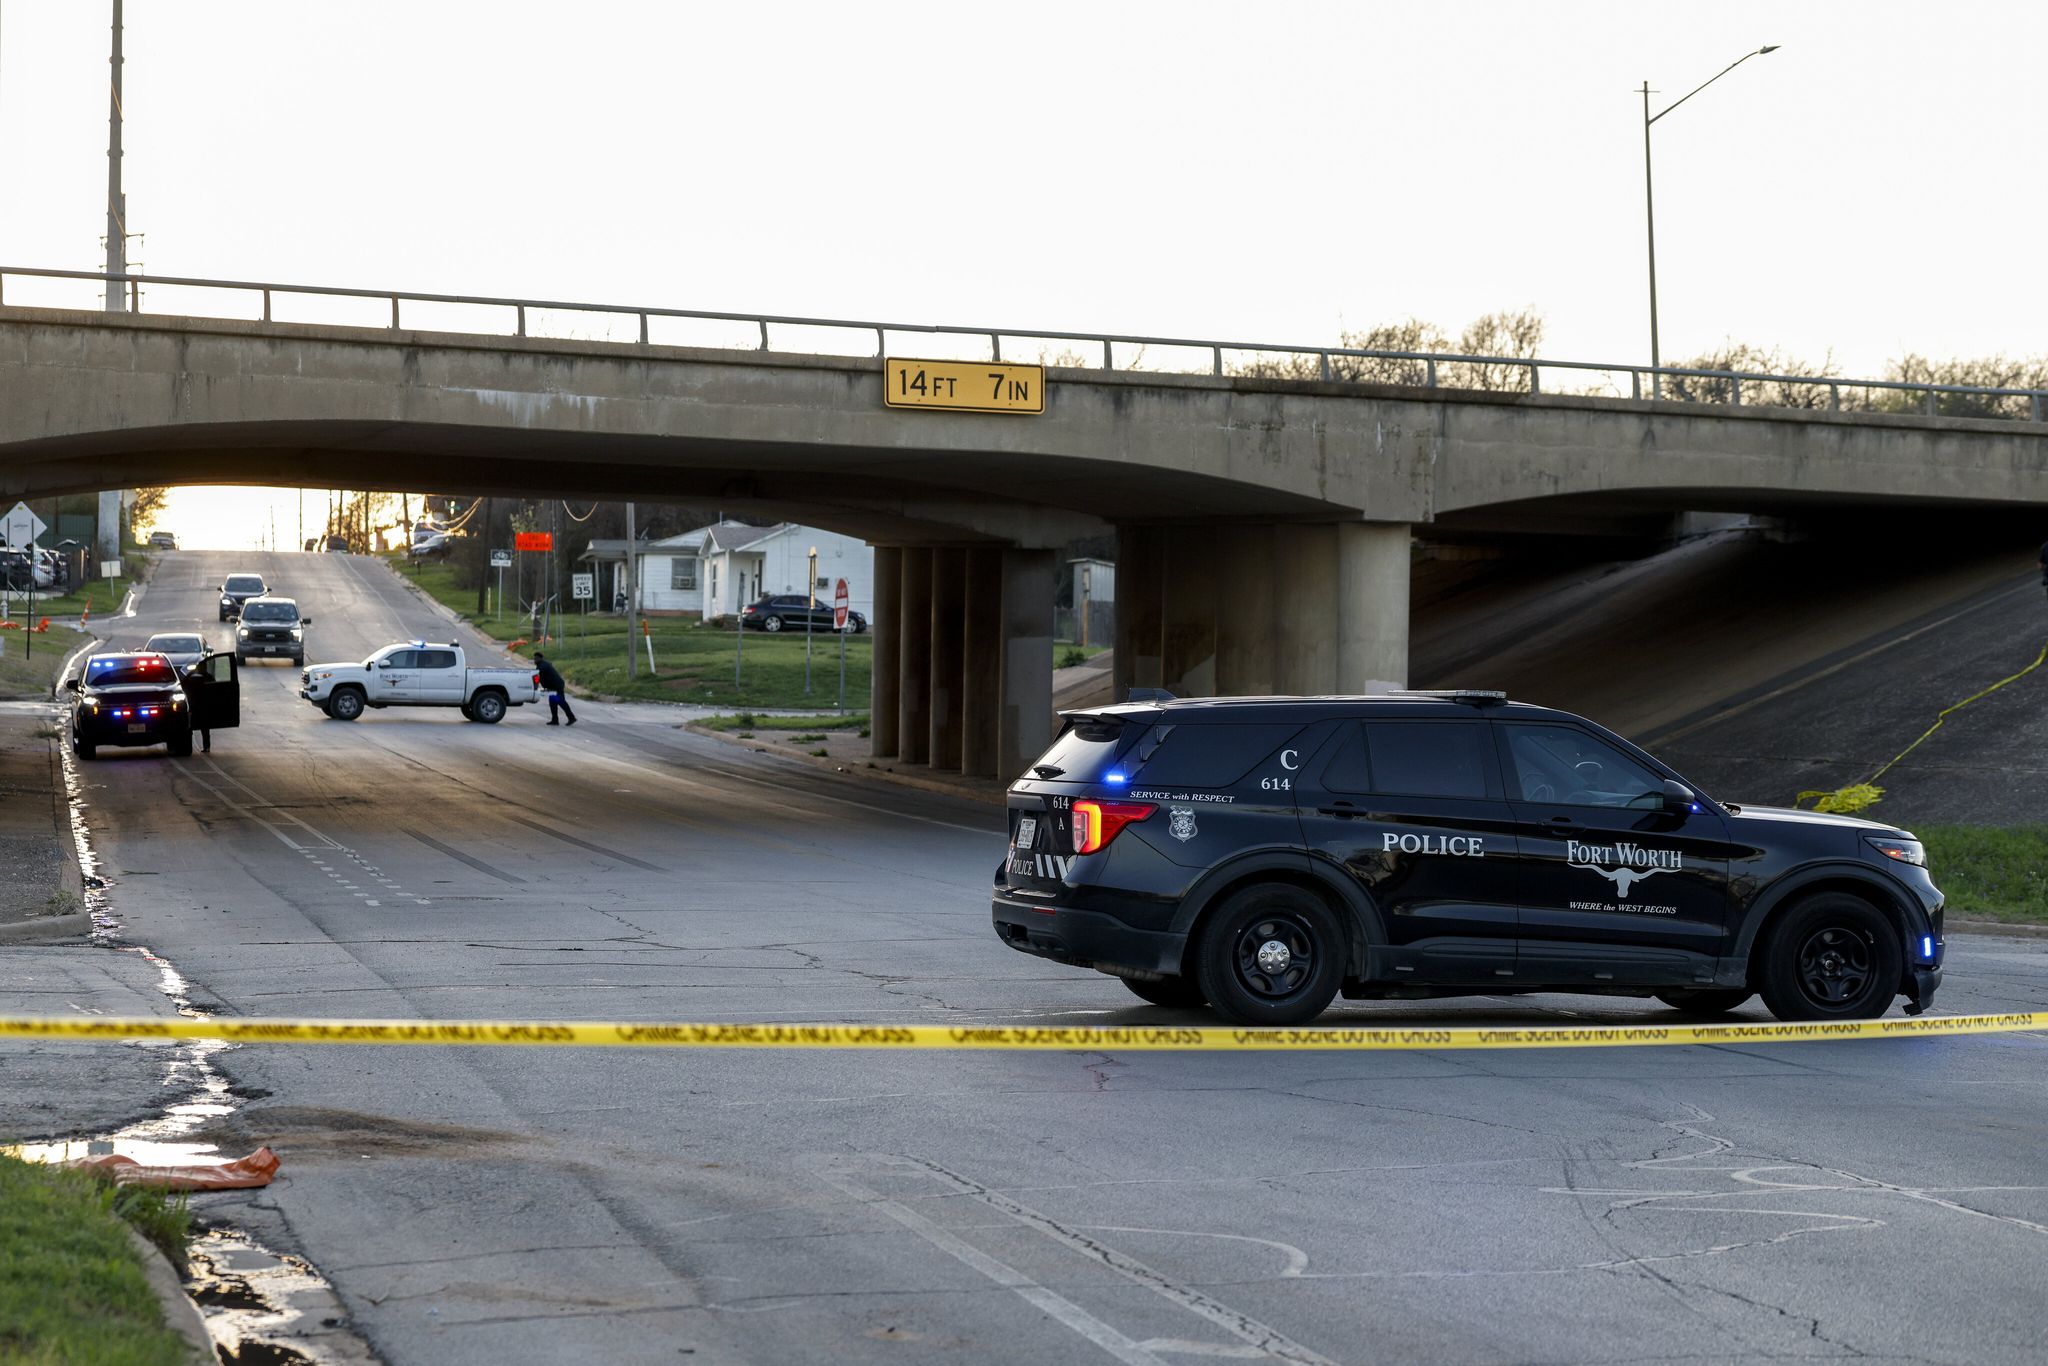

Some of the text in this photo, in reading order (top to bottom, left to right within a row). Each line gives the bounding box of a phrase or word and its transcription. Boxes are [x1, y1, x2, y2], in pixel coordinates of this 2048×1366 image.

[900, 369, 1028, 401] 14 FT 7 IN
[575, 586, 591, 596] 35
[1280, 749, 1299, 770] C
[1261, 777, 1291, 791] 614
[1053, 796, 1069, 810] 614
[1130, 791, 1235, 803] SERVICE with RESPECT
[1058, 817, 1065, 830] A
[1382, 833, 1485, 858] POLICE
[1566, 839, 1683, 868] FORT WORTH
[1012, 858, 1034, 876] POLICE
[1569, 901, 1677, 914] WHERE the WEST BEGINS
